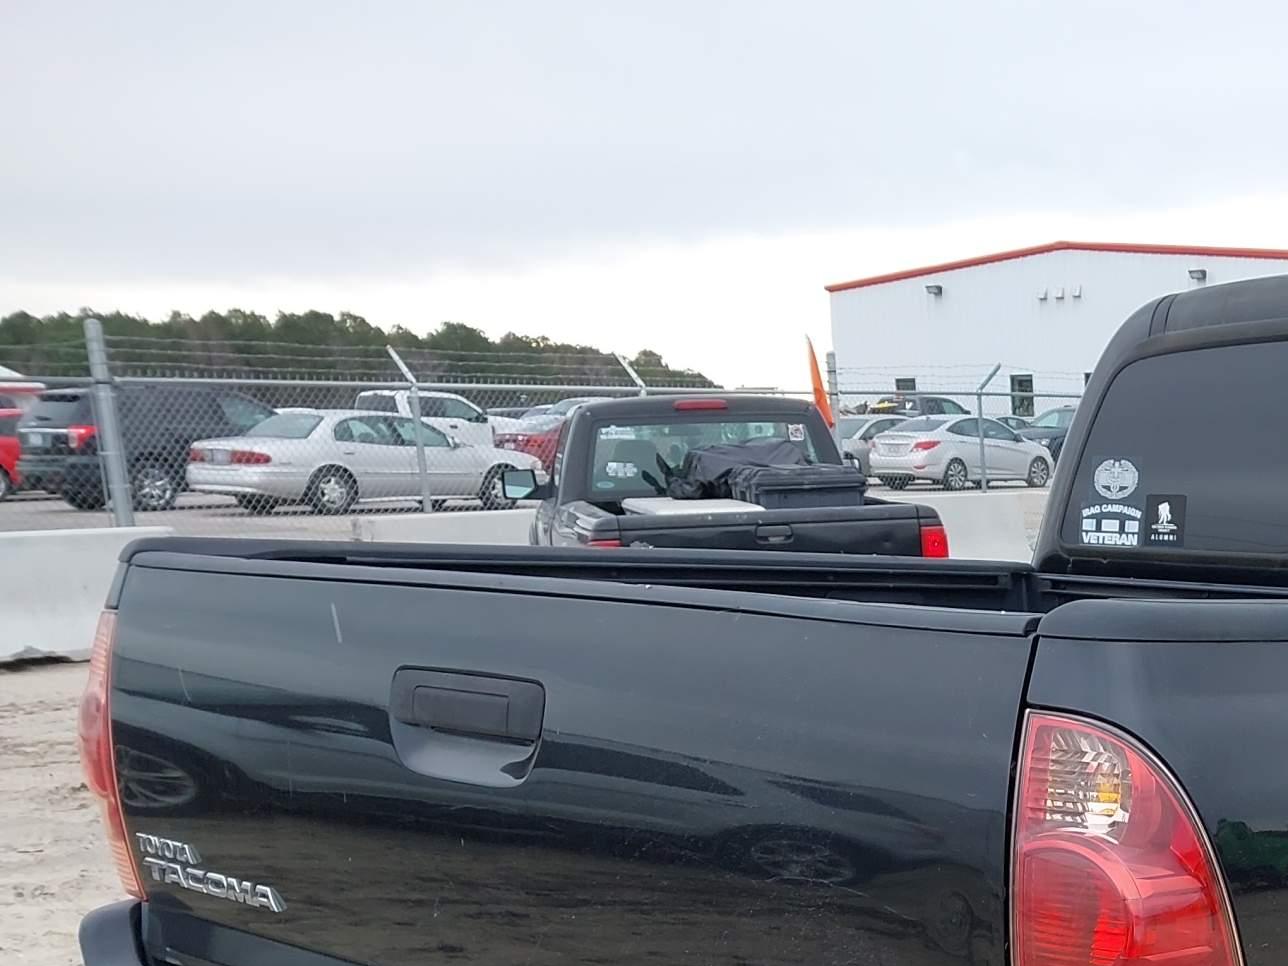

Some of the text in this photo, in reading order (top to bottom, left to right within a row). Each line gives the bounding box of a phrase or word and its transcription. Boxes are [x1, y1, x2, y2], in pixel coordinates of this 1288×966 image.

[1081, 503, 1142, 519] IRAQ CAMPAIGN
[1081, 531, 1138, 546] VETERAN
[136, 832, 200, 865] TOYOTA
[143, 857, 287, 912] TACOMA
